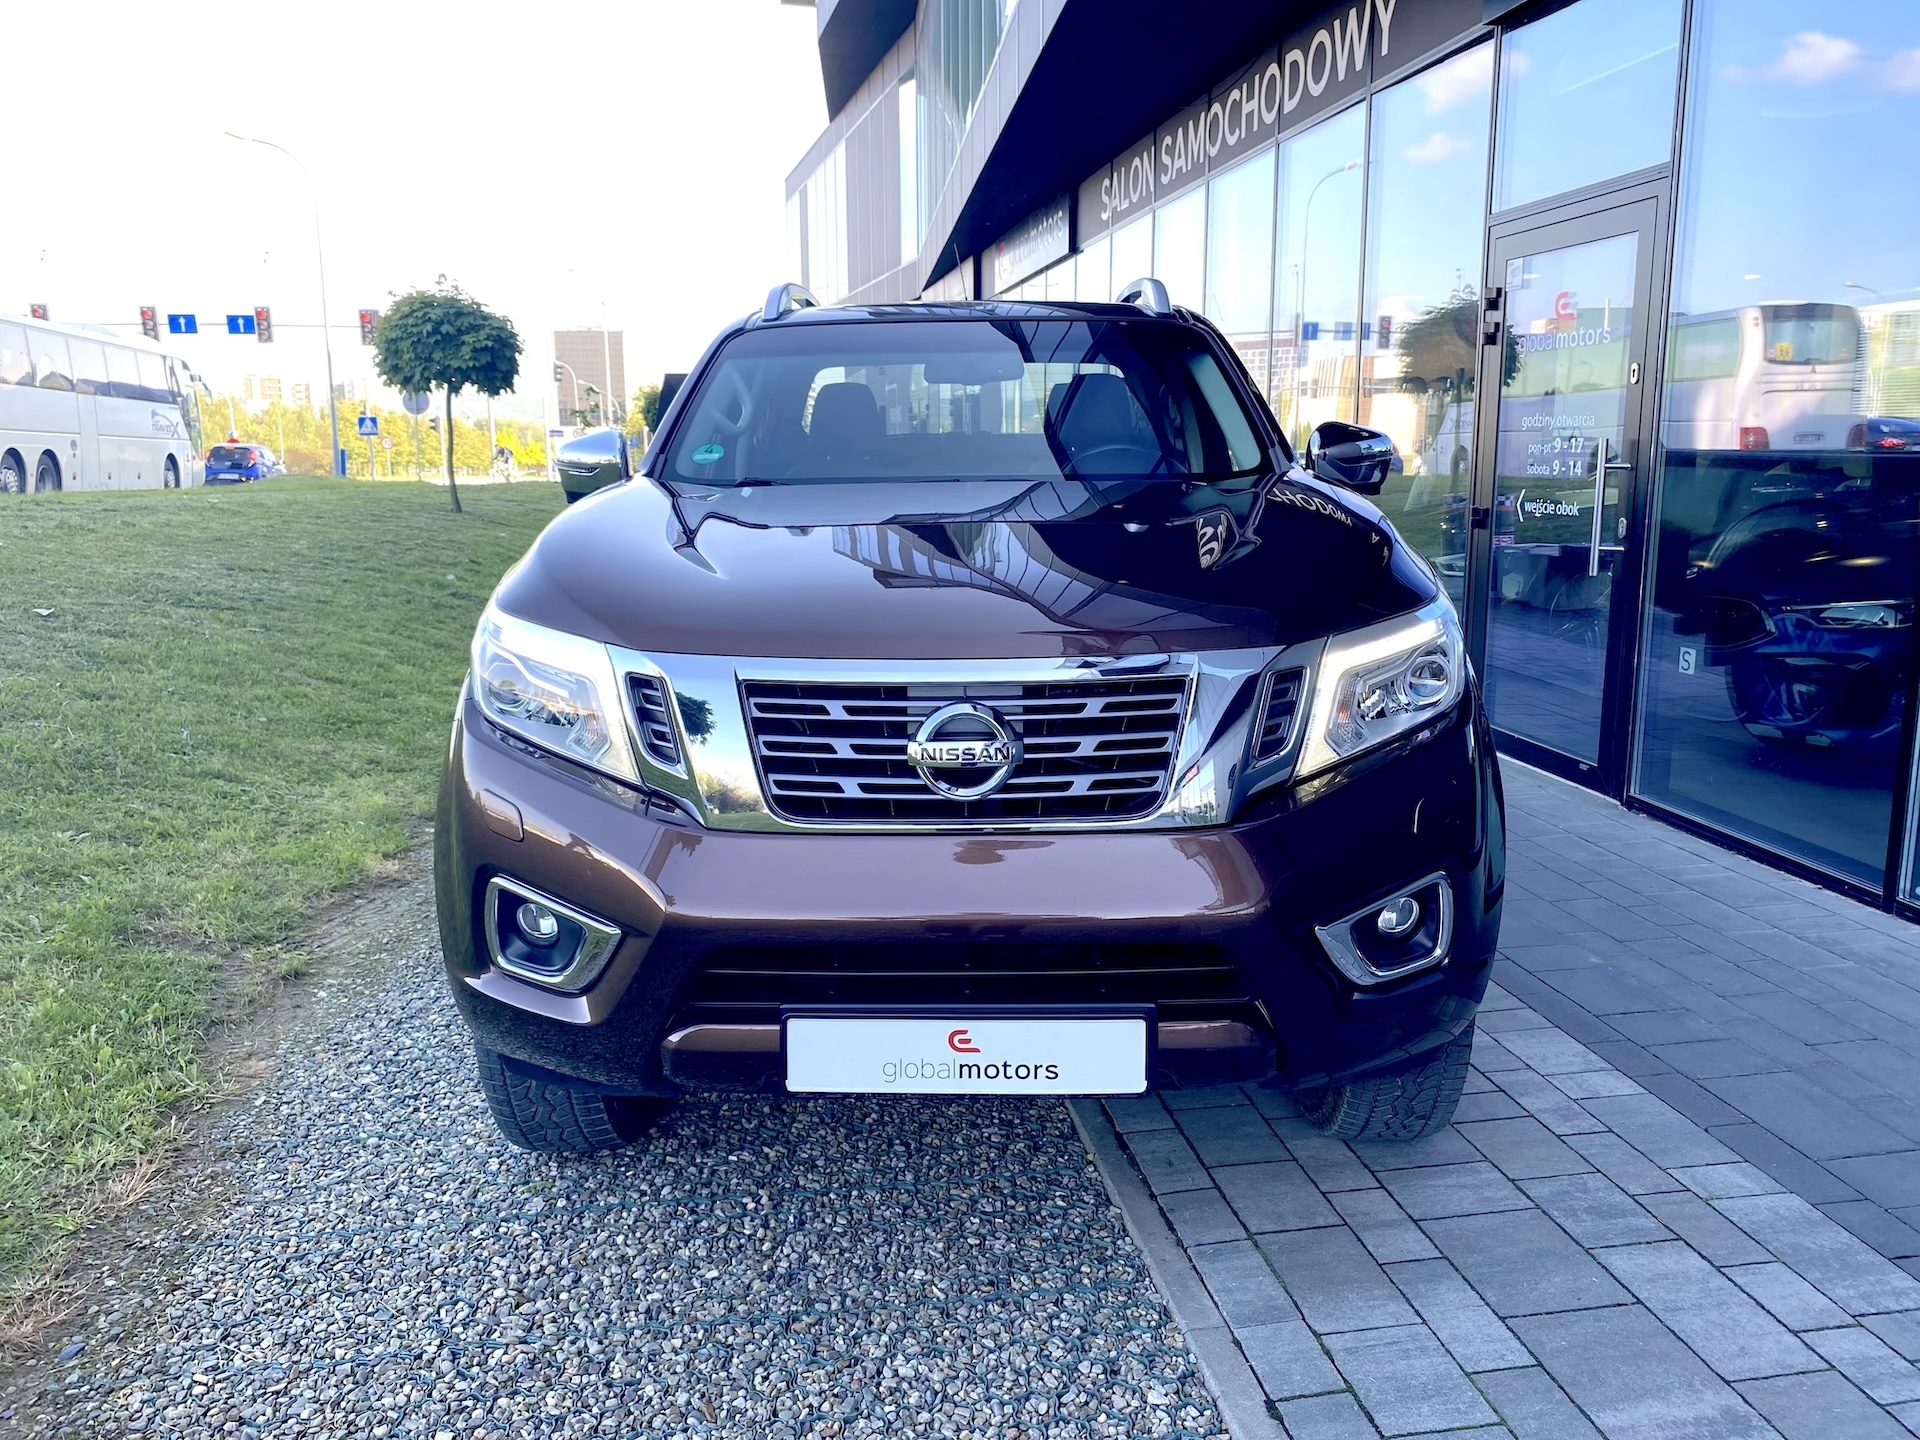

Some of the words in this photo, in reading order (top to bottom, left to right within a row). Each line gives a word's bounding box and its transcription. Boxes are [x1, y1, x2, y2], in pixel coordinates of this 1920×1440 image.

[1101, 146, 1155, 221] SALON
[1160, 0, 1397, 186] SAMOCHODOWY
[1518, 327, 1611, 357] globalmotors
[1522, 412, 1555, 430] godziny
[1556, 411, 1595, 427] otwarcia
[704, 444, 714, 454] 4
[1528, 443, 1552, 455] pon-pt
[1554, 437, 1562, 453] 9
[1570, 438, 1584, 453] 17
[1526, 463, 1550, 475] sobota
[1552, 459, 1560, 475] 9
[1568, 460, 1583, 476] 14
[1524, 499, 1555, 517] wejście
[1556, 501, 1579, 516] obok
[1681, 650, 1692, 671] S
[920, 746, 1012, 762] NISSAN
[882, 1058, 1059, 1083] globalmotors
